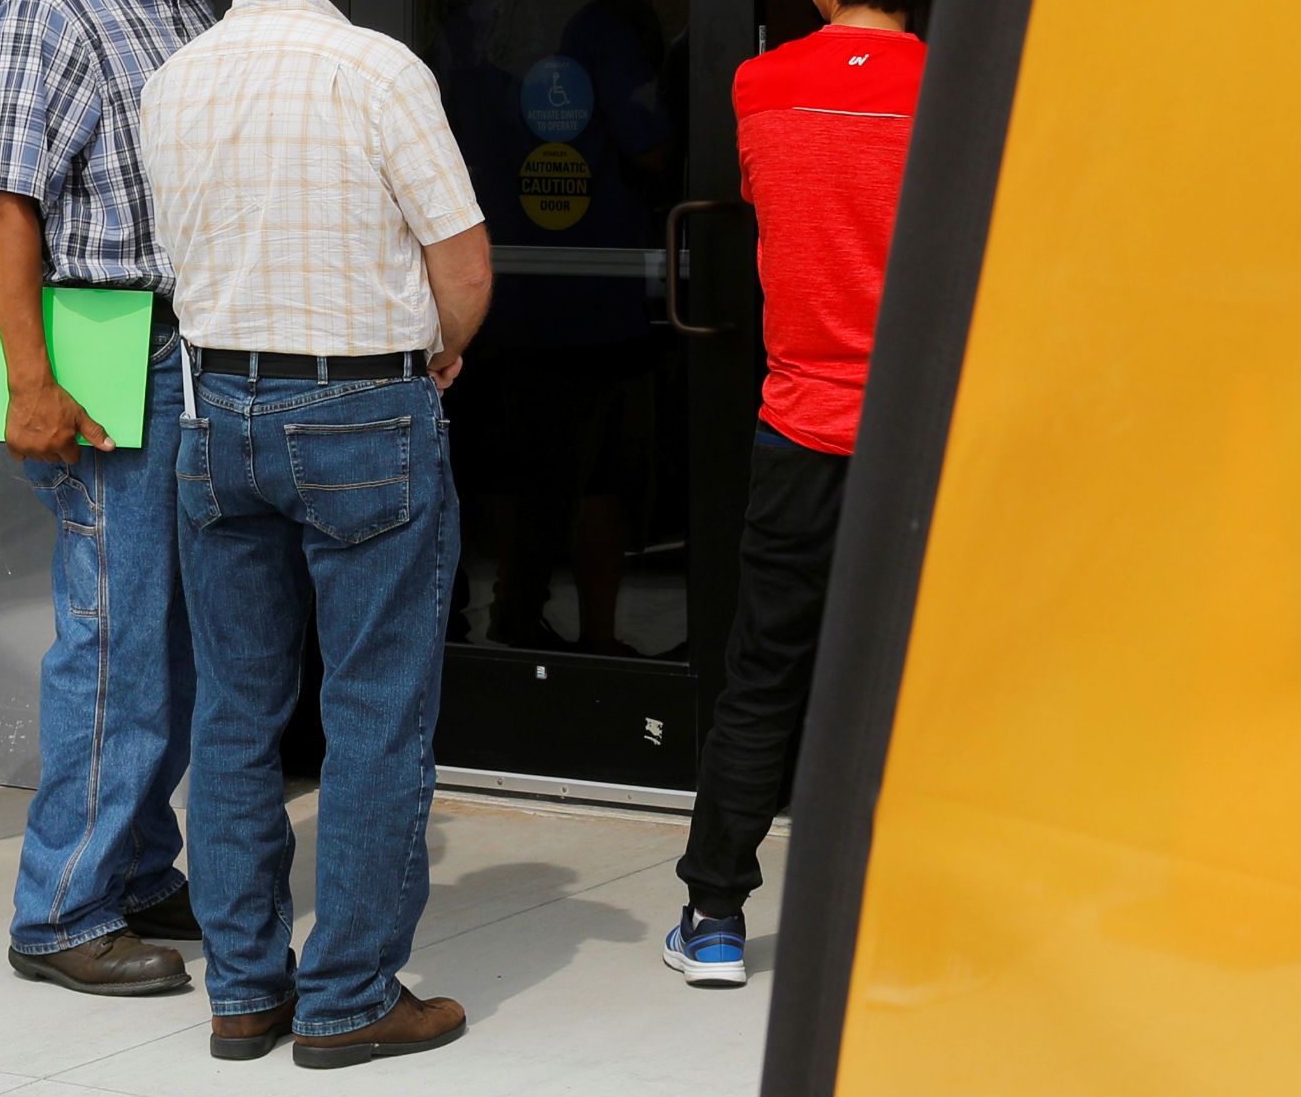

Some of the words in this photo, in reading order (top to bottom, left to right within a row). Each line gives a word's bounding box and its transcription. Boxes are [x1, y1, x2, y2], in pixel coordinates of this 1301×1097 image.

[527, 109, 560, 119] ACTIVATE
[560, 109, 588, 119] SWITCH
[537, 120, 546, 131] TO
[547, 120, 579, 131] OPERATE
[525, 161, 586, 173] AUTOMATIC
[521, 178, 587, 194] CAUTION
[540, 200, 571, 212] DOOR
